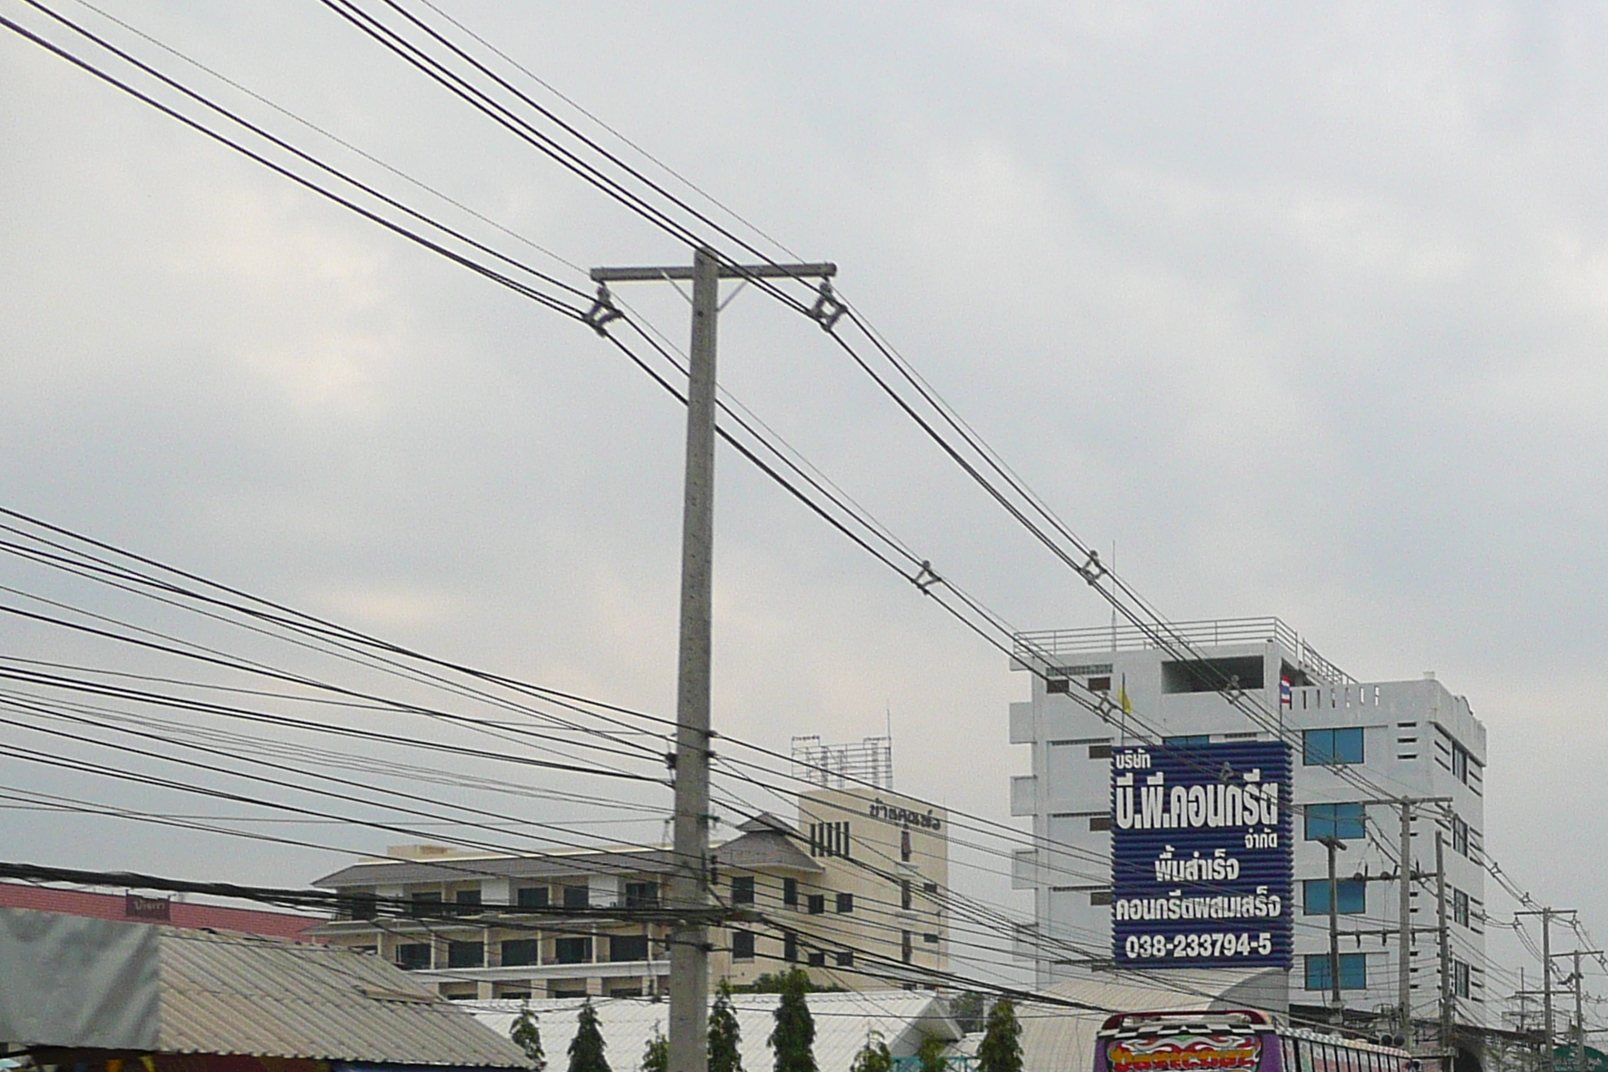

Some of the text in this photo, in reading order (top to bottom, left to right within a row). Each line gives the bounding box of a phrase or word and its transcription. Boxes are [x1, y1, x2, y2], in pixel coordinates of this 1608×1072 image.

[1116, 749, 1151, 769] บริษัท
[1244, 828, 1278, 849] จำกัด
[1154, 845, 1240, 882] พื้นสำเร็จ
[1126, 933, 1272, 958] 038-233794-5
